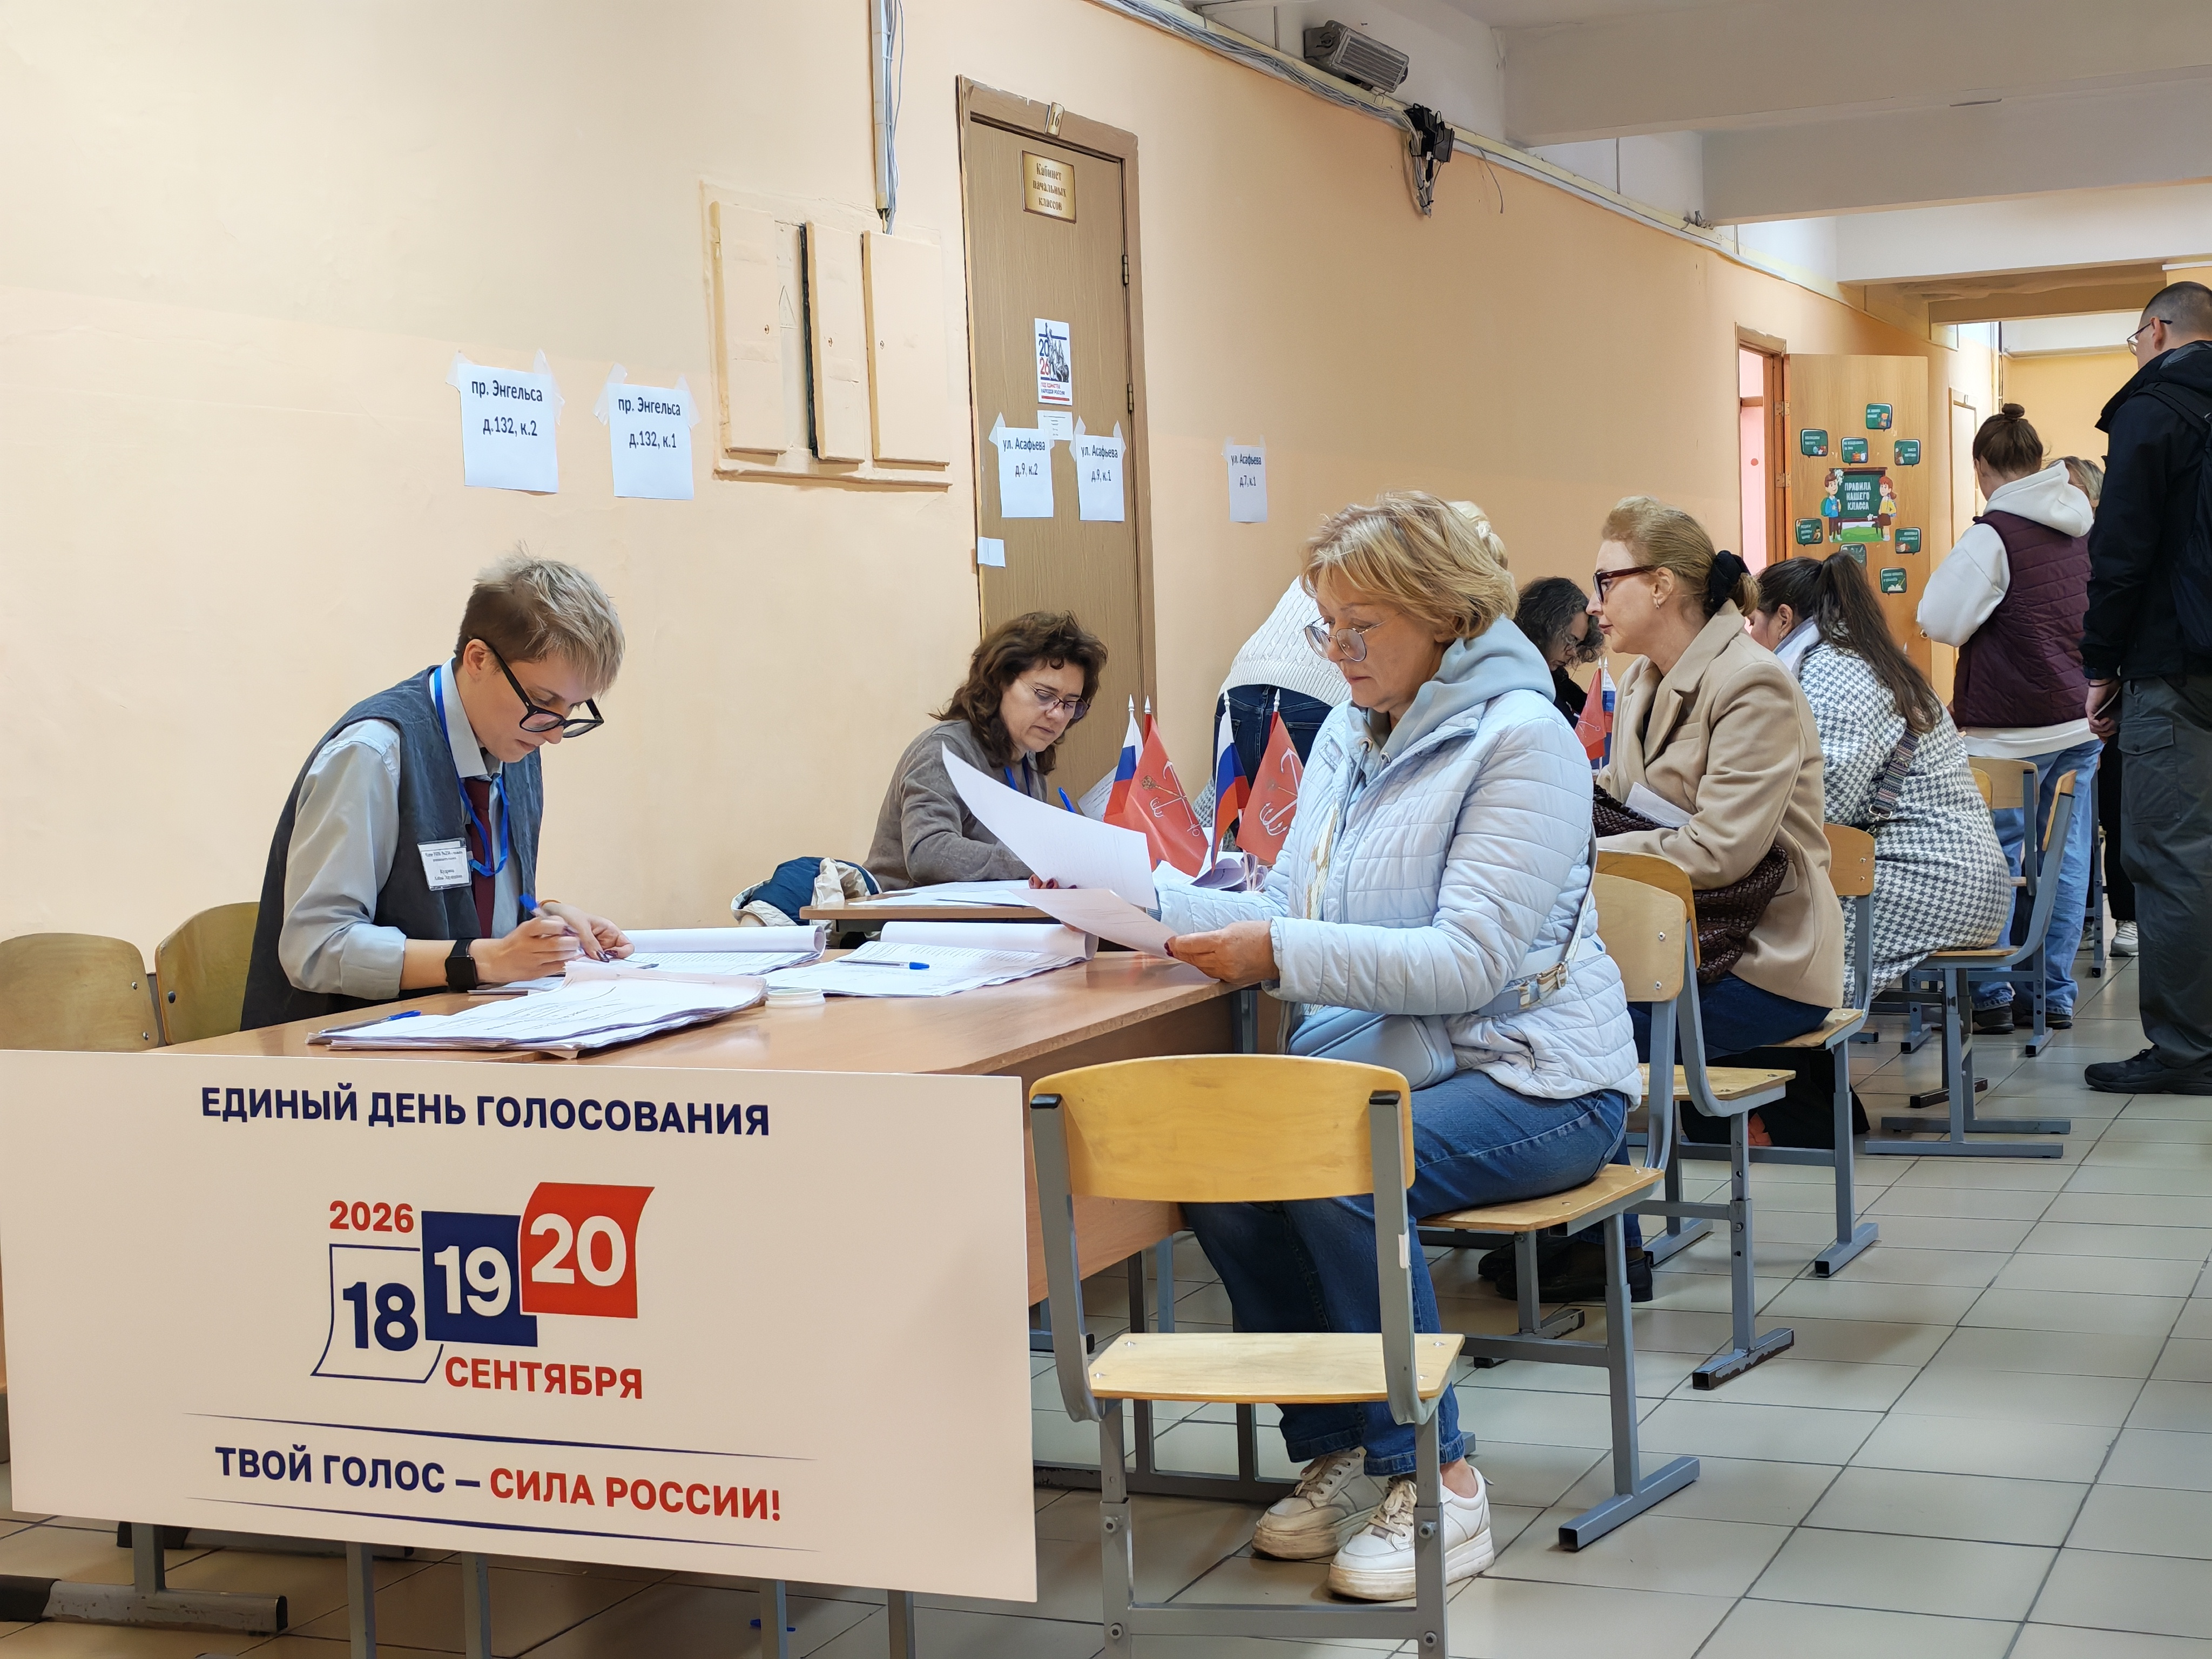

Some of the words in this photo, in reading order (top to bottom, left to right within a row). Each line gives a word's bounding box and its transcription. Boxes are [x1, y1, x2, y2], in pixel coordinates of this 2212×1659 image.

[1036, 163, 1062, 181] Кабинет
[1033, 180, 1067, 197] начальных
[1038, 197, 1062, 211] классов
[471, 381, 489, 399] пр.
[492, 380, 543, 402] Энгельса
[618, 399, 635, 415] пр.
[637, 396, 681, 416] Энгельса
[483, 416, 517, 437] д.132,
[520, 420, 538, 436] к.2
[629, 430, 660, 449] д.132,
[663, 433, 677, 448] к.1
[1002, 440, 1013, 452] ул.
[1015, 437, 1046, 453] Асафьева
[1081, 447, 1091, 458] ул.
[1092, 444, 1118, 460] Асафьева
[1239, 453, 1262, 467] Асафьева
[1028, 463, 1038, 475] к.2
[1102, 469, 1111, 482] к.1
[1844, 482, 1872, 491] ПРАВИЛА
[1846, 492, 1870, 501] НАШЕГО
[1847, 502, 1869, 510] КЛАССА
[202, 1082, 357, 1123] ЕДИНЫЙ
[368, 1092, 466, 1128] ДЕНЬ
[477, 1095, 769, 1136] ГОЛОСОВАНИЯ
[329, 1200, 414, 1233] 2026
[342, 1282, 419, 1352] 18
[434, 1245, 511, 1317] 19
[530, 1213, 626, 1286] 20
[445, 1356, 643, 1399] СЕНТЯБРЯ
[215, 1444, 312, 1483] ТВОЙ
[323, 1454, 445, 1493] ГОЛОС
[490, 1468, 595, 1506] СИЛА
[606, 1476, 780, 1521] РОССИИ!
